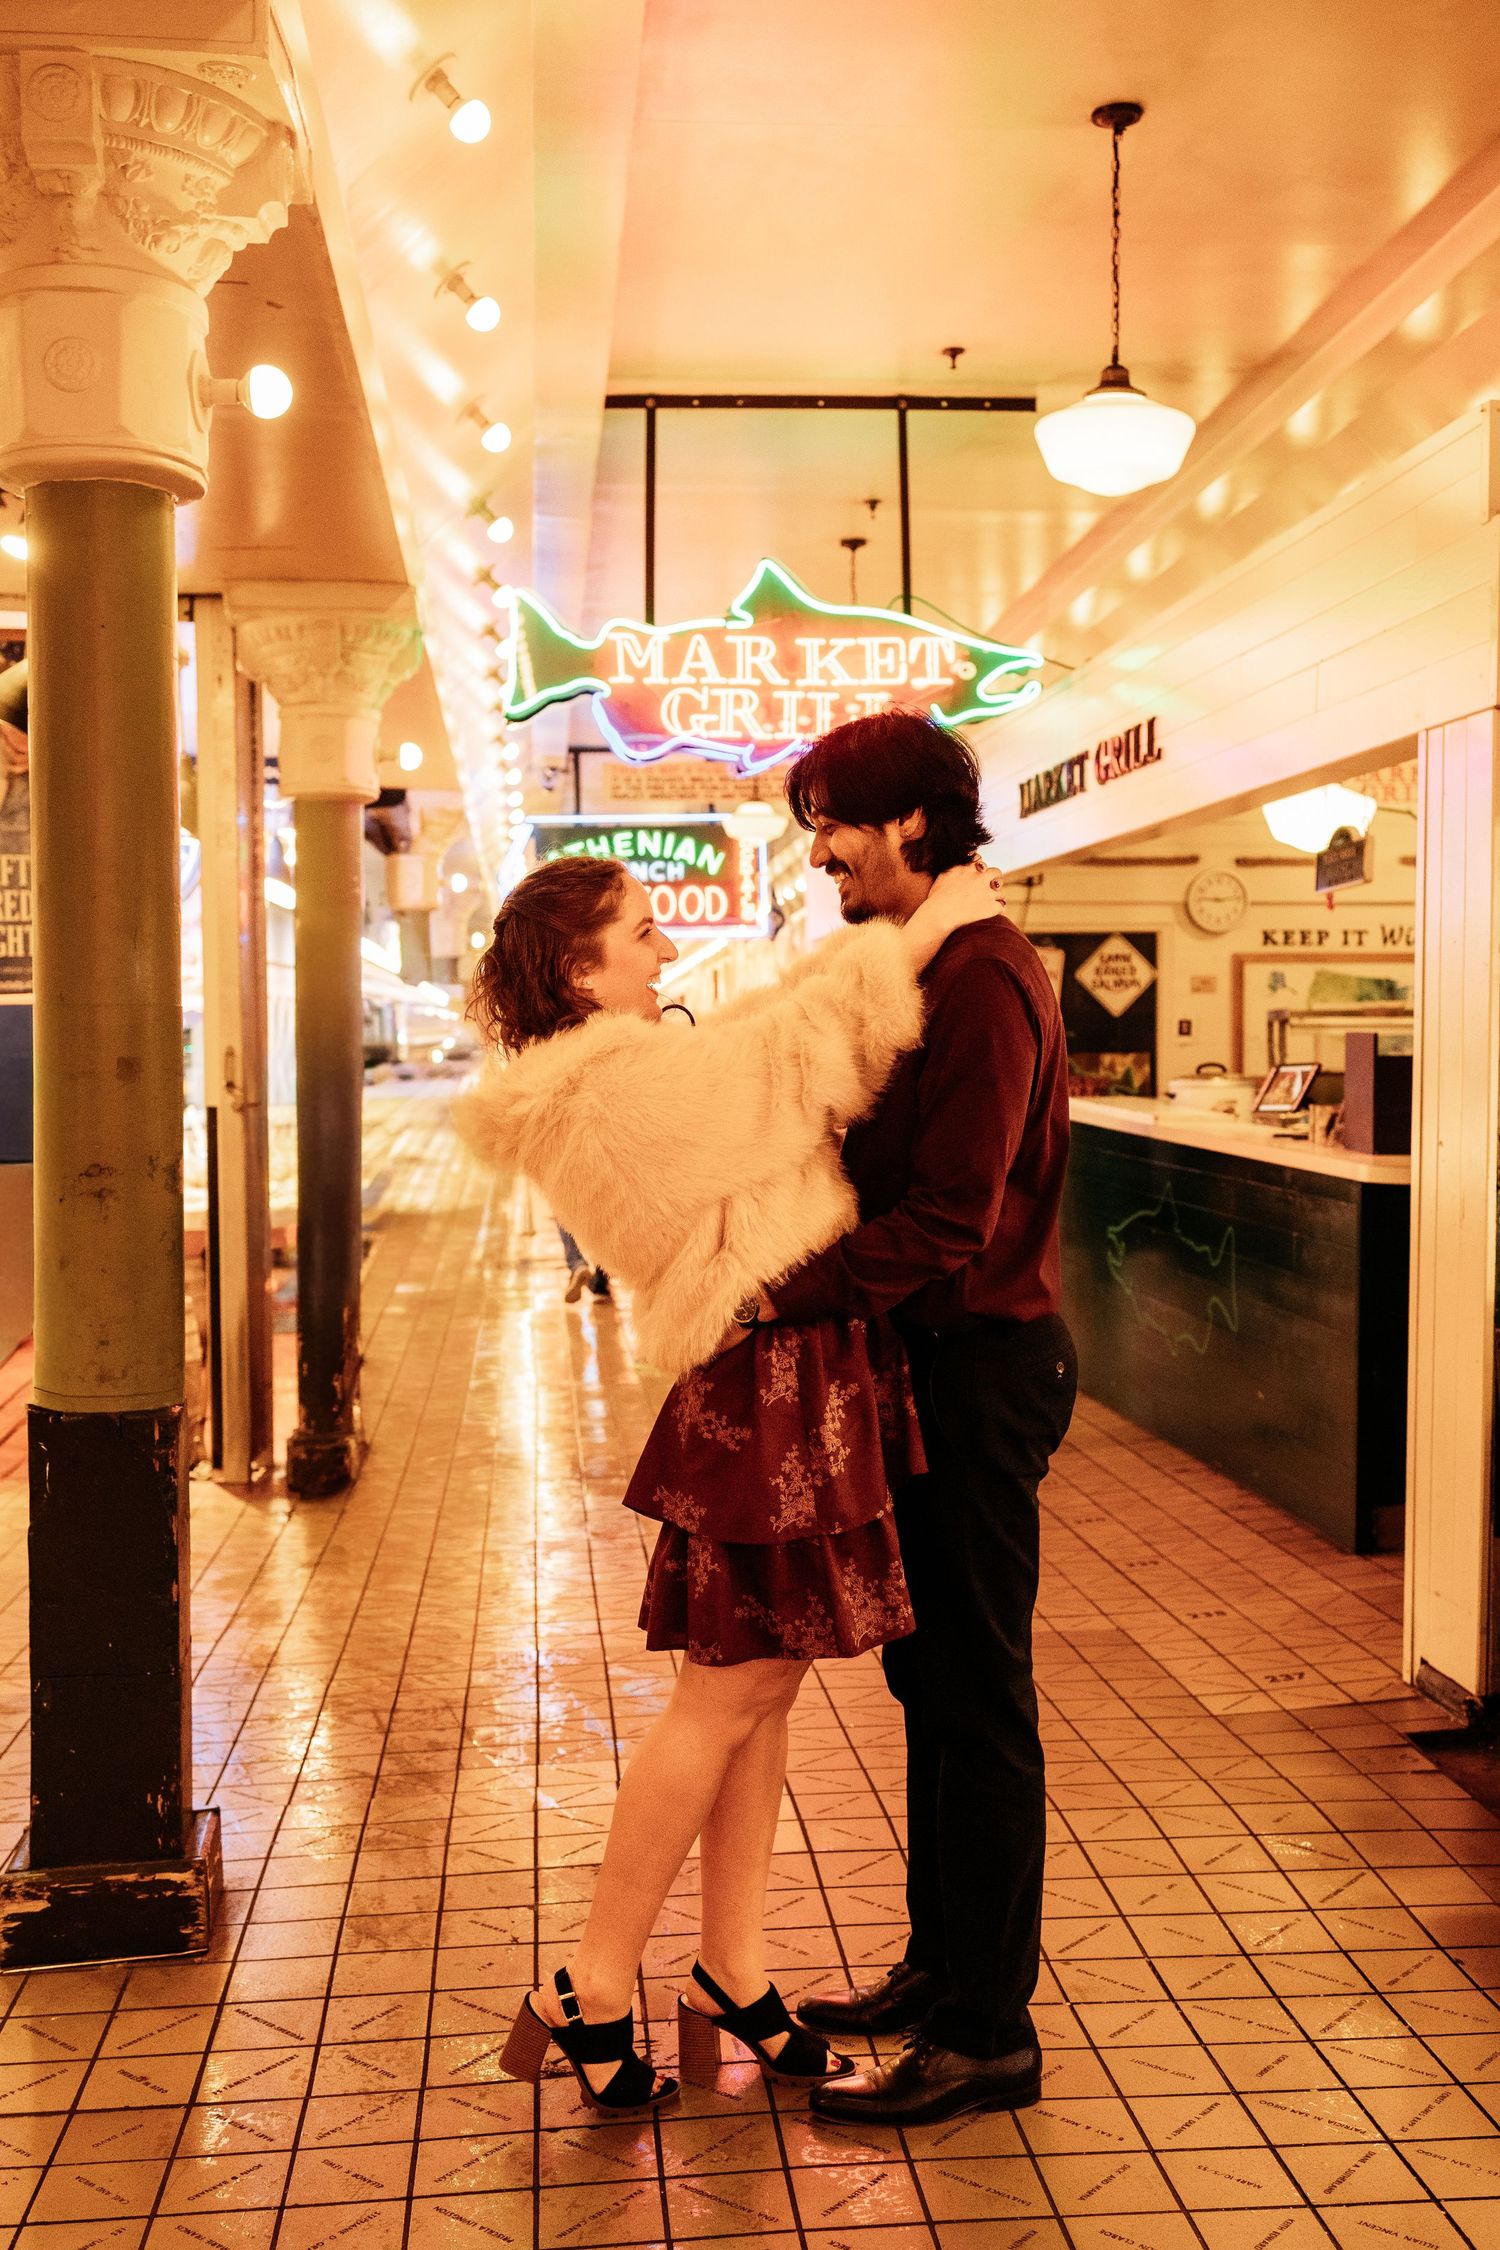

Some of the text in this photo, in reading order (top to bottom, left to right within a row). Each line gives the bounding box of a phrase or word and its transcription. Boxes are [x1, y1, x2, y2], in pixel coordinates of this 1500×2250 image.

[608, 632, 956, 687] MARKET
[1019, 716, 1162, 819] MARKET GRILL
[547, 829, 725, 876] THENIAN
[628, 860, 686, 883] NCH
[1261, 929, 1330, 947] KEEP
[1342, 929, 1368, 947] IT
[1264, 1671, 1306, 1684] 237
[1037, 2028, 1067, 2039] ROGER
[1254, 2022, 1291, 2035] SHARON
[1128, 2057, 1197, 2081] SCOTT ENDICOTT
[1406, 2066, 1439, 2079] DAWN
[220, 2075, 254, 2090] FAMILY
[446, 2095, 473, 2108] GRANT
[1256, 2098, 1288, 2111] DIEGO
[365, 2105, 386, 2115] AND
[483, 2108, 513, 2122] DUSTIN
[1030, 2107, 1059, 2119] JERRY
[1288, 2108, 1311, 2117] SAN
[341, 2114, 367, 2127] JOAN
[1058, 2116, 1082, 2127] MIKE
[1325, 2118, 1367, 2134] PATRICIA
[253, 2131, 277, 2142] MARY
[312, 2125, 344, 2141] GRANT
[1093, 2128, 1113, 2137] RAY
[88, 2134, 119, 2148] DAVID
[432, 2140, 514, 2183] PATRICK AND SUSAN
[1356, 2150, 1377, 2164] DIANE
[1415, 2148, 1447, 2161] DIEGO
[319, 2158, 344, 2170] LEWIS
[1112, 2163, 1132, 2175] DICK
[1449, 2158, 1472, 2168] SAN
[184, 2162, 264, 2201] JOHN BARNARD
[349, 2171, 386, 2189] ELEANOR
[864, 2172, 889, 2187] MARY
[1098, 2174, 1117, 2185] AND
[1320, 2167, 1357, 2195] SUTHERLAND
[93, 2185, 114, 2196] AND
[619, 2188, 645, 2202] EVAN
[844, 2185, 869, 2200] ELLEN
[335, 2210, 383, 2235] STEPHANIE
[431, 2204, 516, 2243] PRISCILLA LIVINGSTON
[754, 2211, 781, 2224] LENA
[172, 2223, 207, 2241] FRANCIS
[1252, 2217, 1296, 2250] KEITH EDWARD
[1356, 2219, 1401, 2237] VINCENT
